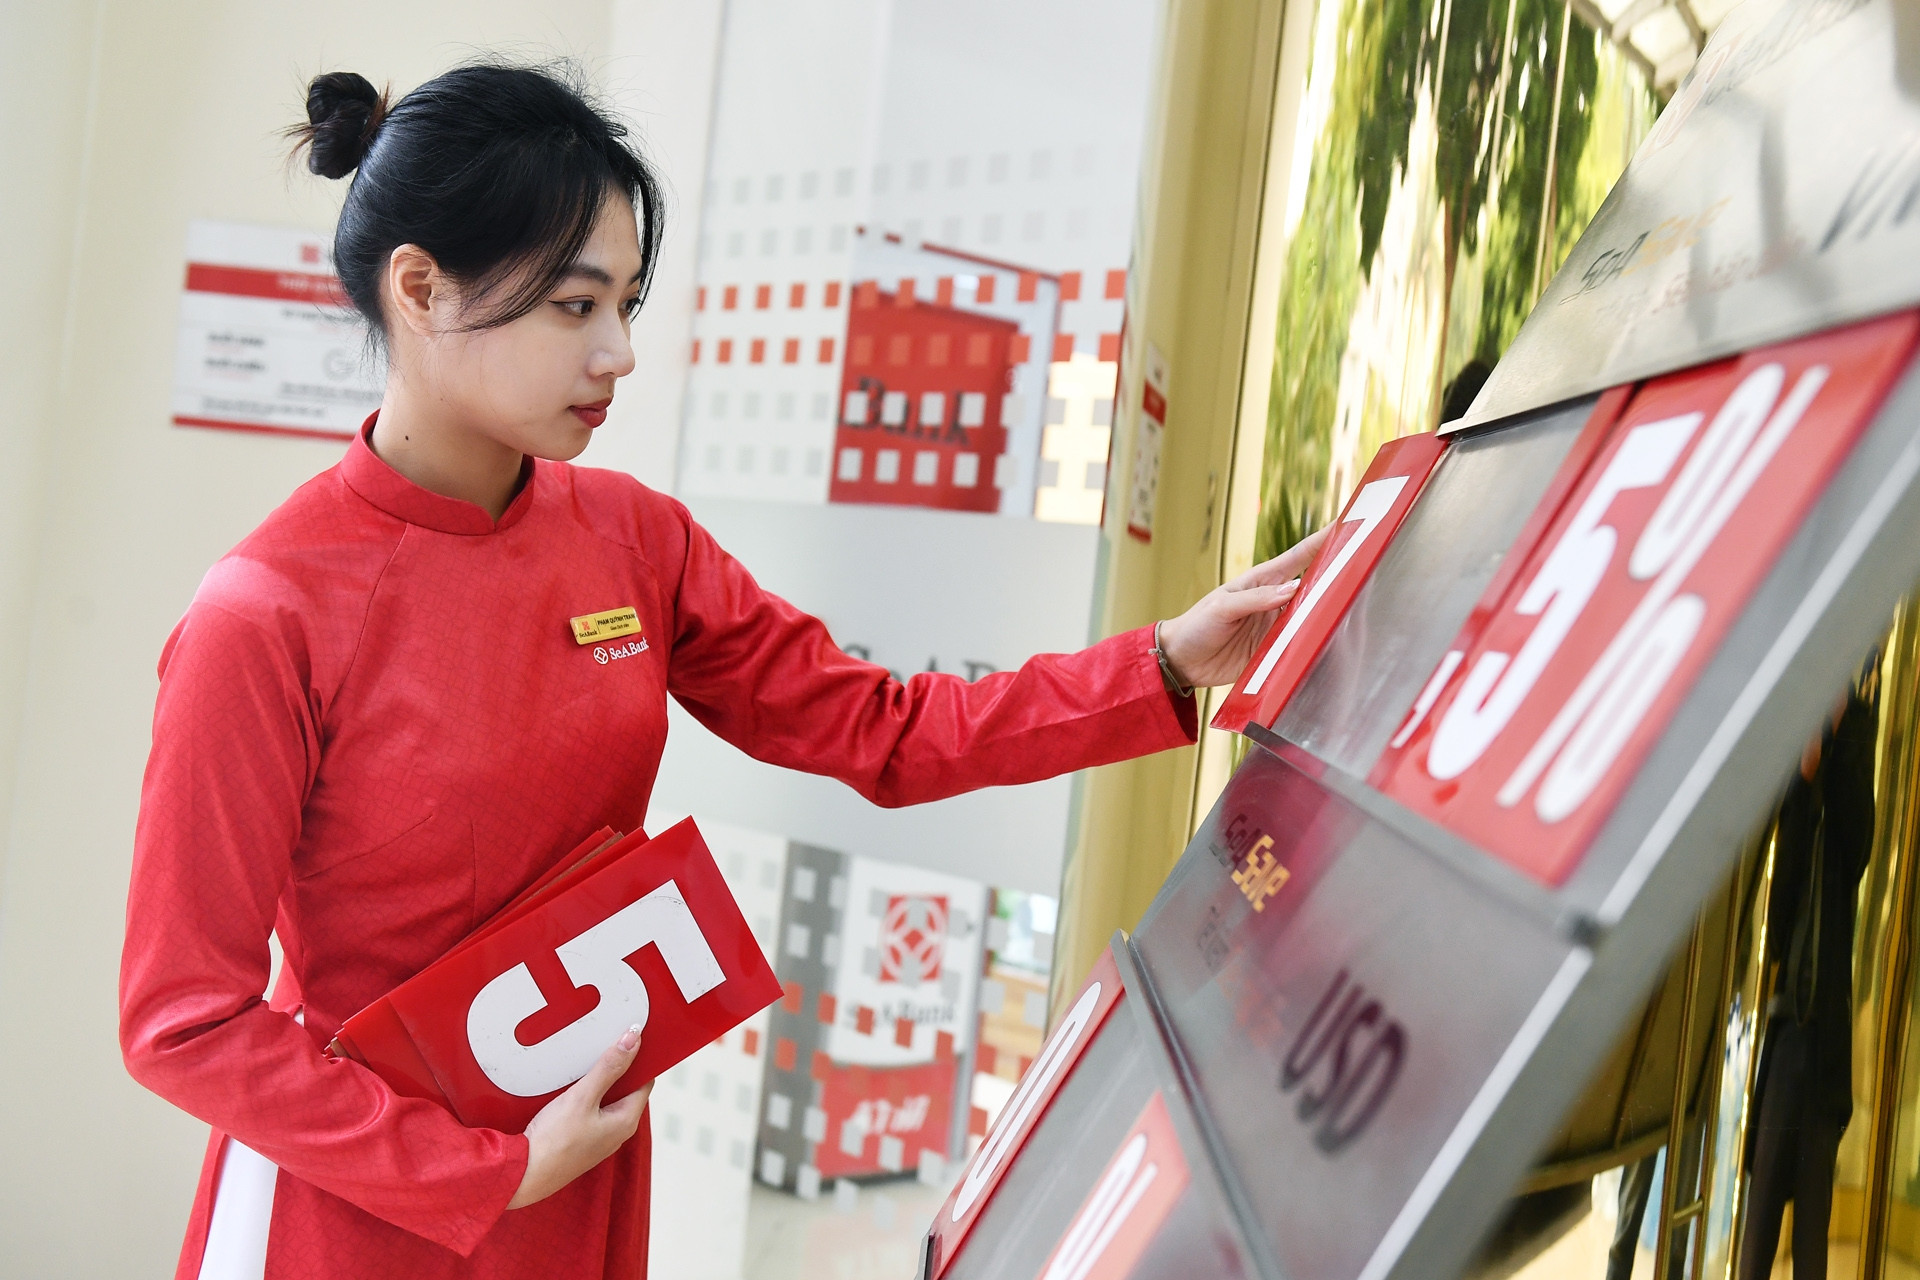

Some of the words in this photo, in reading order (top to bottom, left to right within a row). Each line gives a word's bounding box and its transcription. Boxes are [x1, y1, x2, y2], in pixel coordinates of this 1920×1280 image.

[608, 636, 650, 660] SeABank
[1243, 475, 1410, 695] 7
[466, 878, 727, 1097] 5
[1278, 965, 1409, 1156] USD
